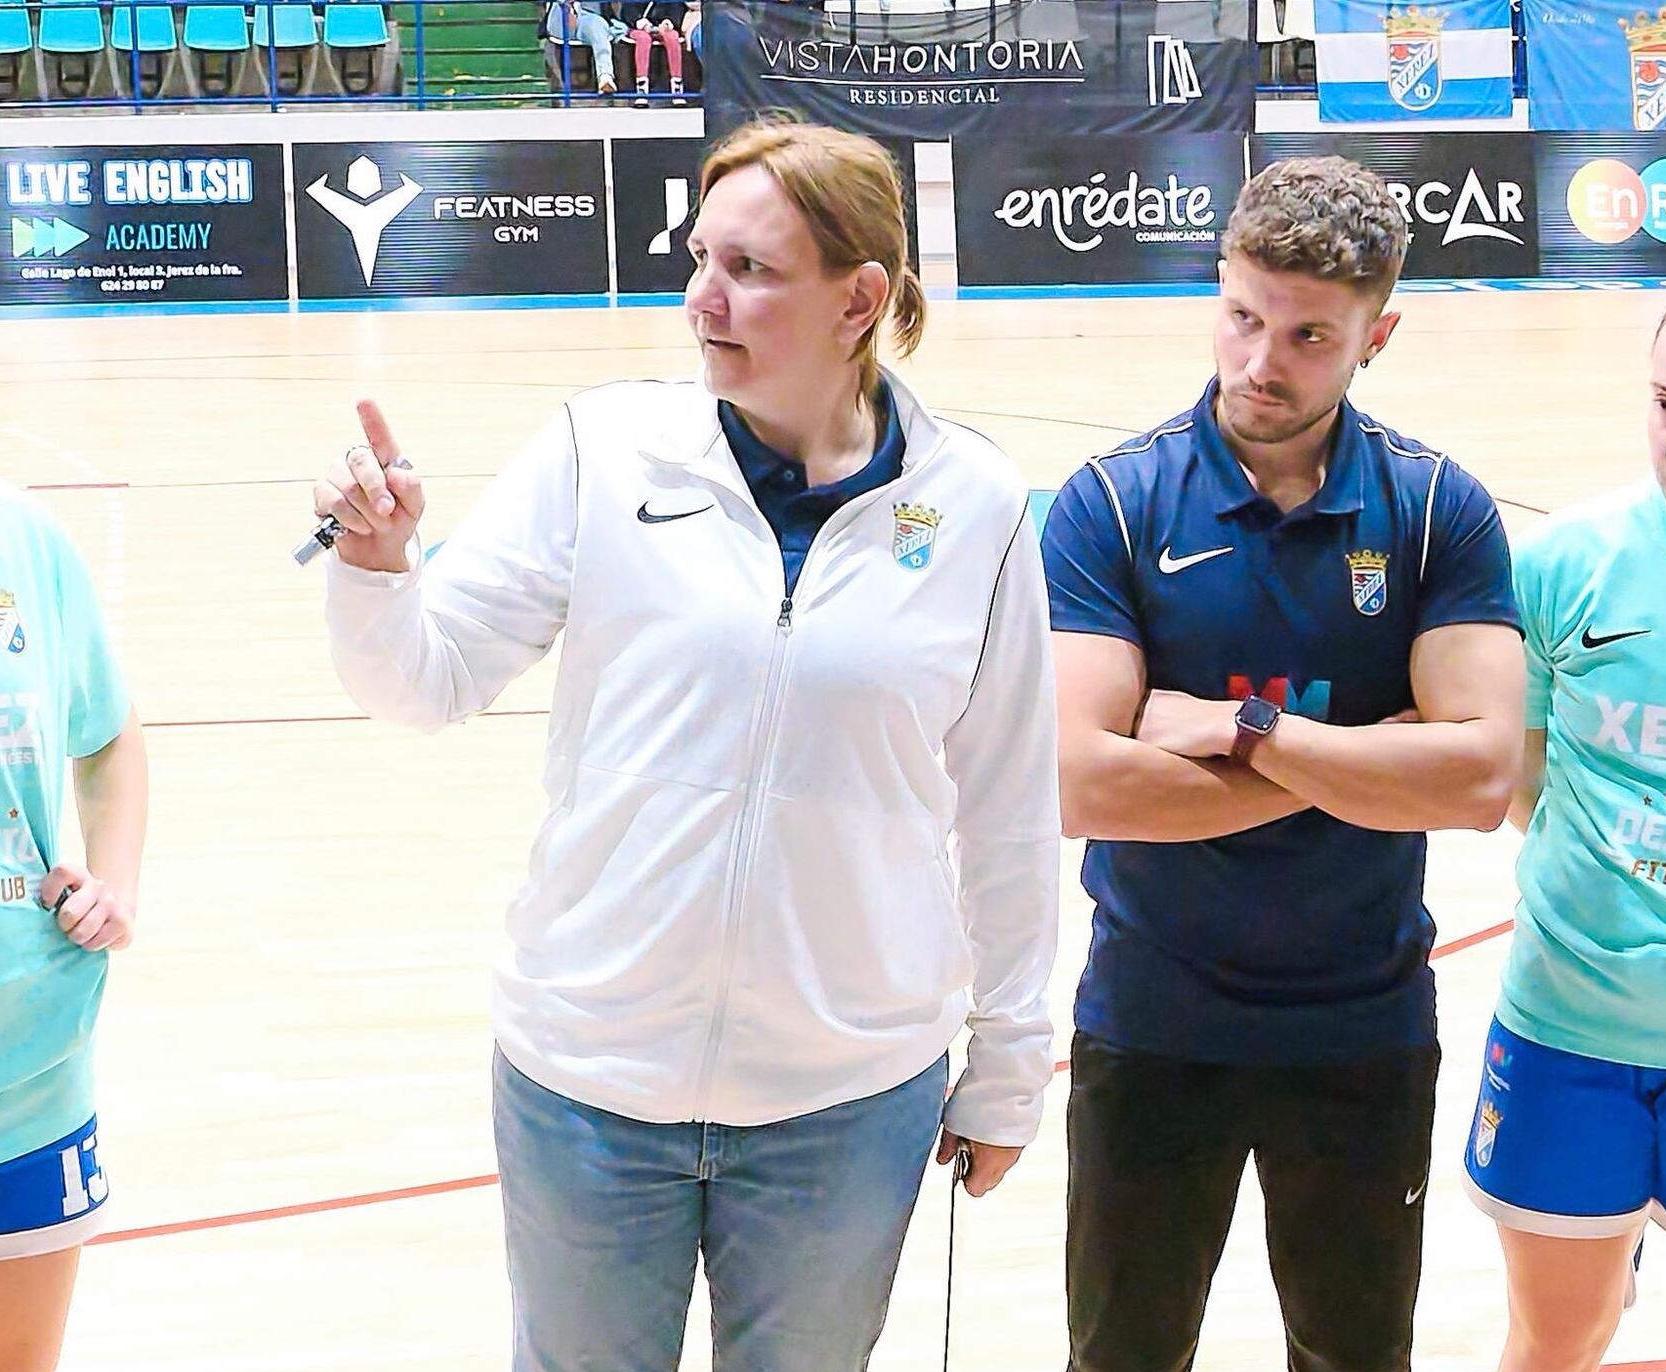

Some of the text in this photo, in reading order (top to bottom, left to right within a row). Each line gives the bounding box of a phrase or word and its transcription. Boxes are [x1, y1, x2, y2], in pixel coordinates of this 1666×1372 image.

[759, 37, 1085, 74] VISTAHONTORIA
[850, 87, 1000, 105] RESIDENCIAL
[6, 159, 253, 205] LIVE ENGLISH
[434, 195, 596, 219] FEATNESS
[993, 171, 1216, 252] enrédate
[1585, 183, 1638, 219] En
[105, 223, 212, 251] ACADEMY
[493, 226, 540, 243] GYM
